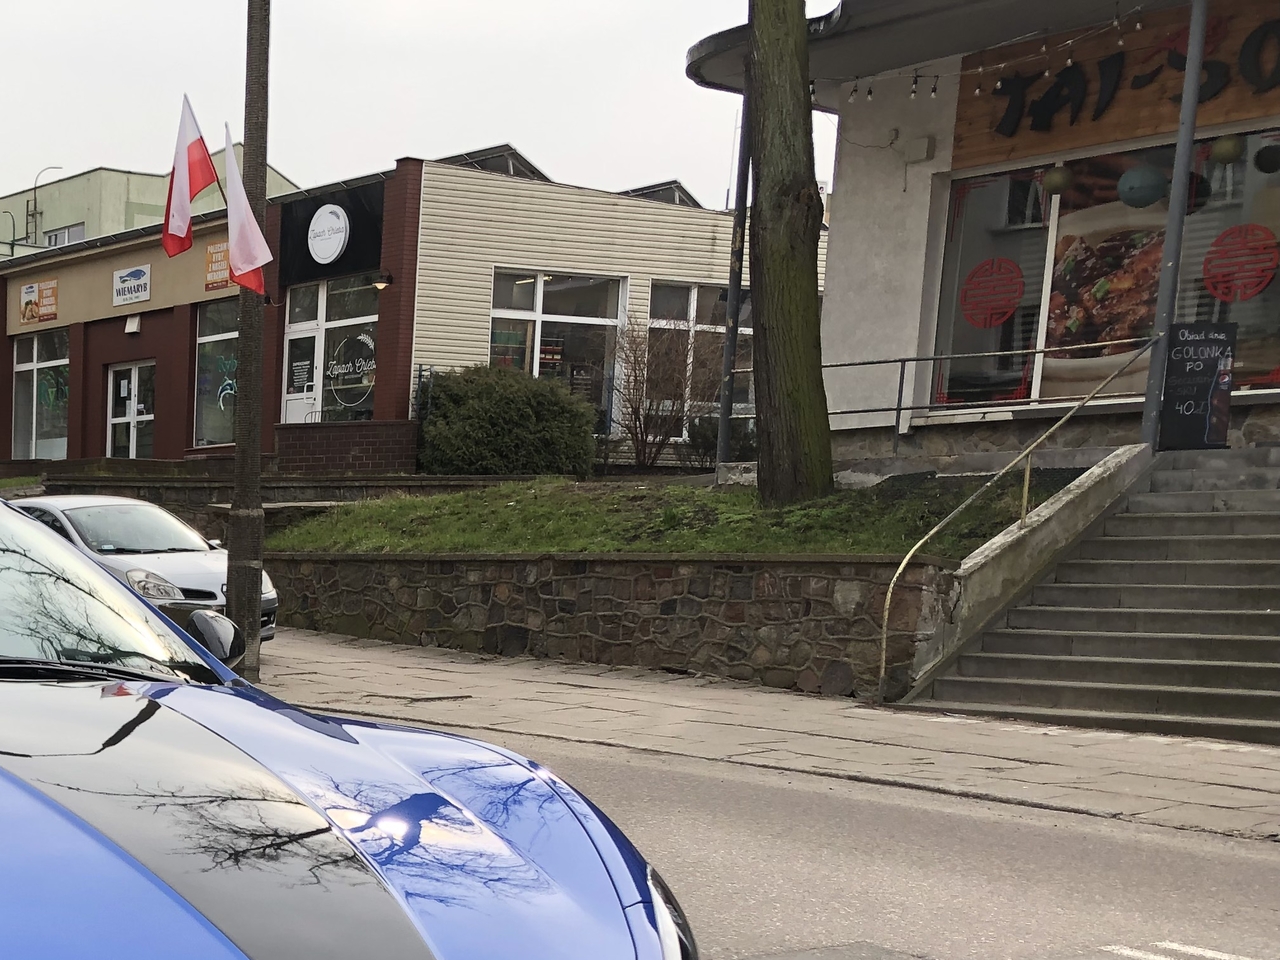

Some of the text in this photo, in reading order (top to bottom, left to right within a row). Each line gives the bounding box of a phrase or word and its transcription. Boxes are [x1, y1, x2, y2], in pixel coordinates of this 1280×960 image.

[115, 282, 148, 298] WIEMARYB
[1172, 346, 1233, 360] GOLONKA
[1186, 361, 1204, 372] PO
